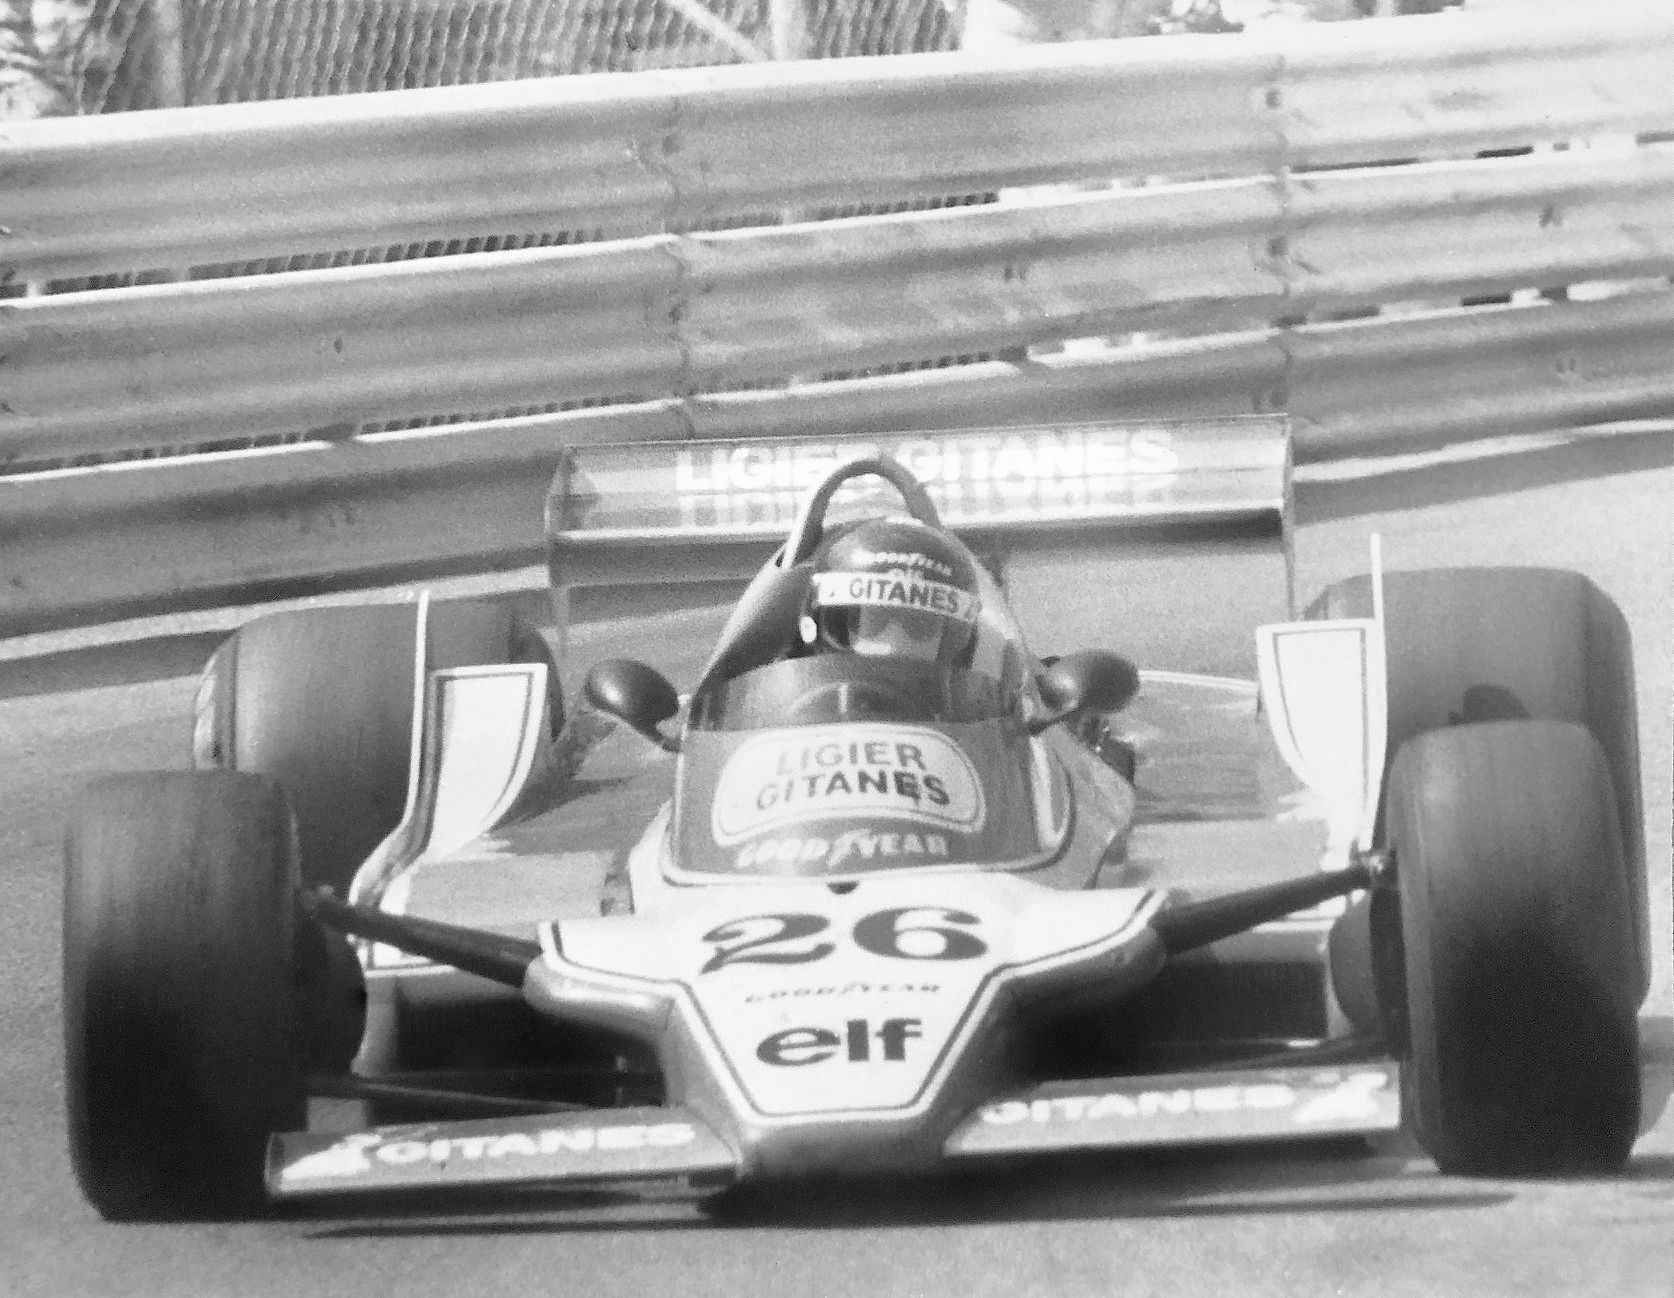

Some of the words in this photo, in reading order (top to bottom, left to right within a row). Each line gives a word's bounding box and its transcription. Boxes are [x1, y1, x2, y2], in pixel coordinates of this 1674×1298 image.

[894, 428, 1179, 482] GITANES
[849, 576, 960, 614] GITANES
[777, 741, 927, 776] LIGIER
[755, 769, 952, 811] GITANES
[700, 906, 989, 975] 26
[756, 1017, 923, 1067] elf
